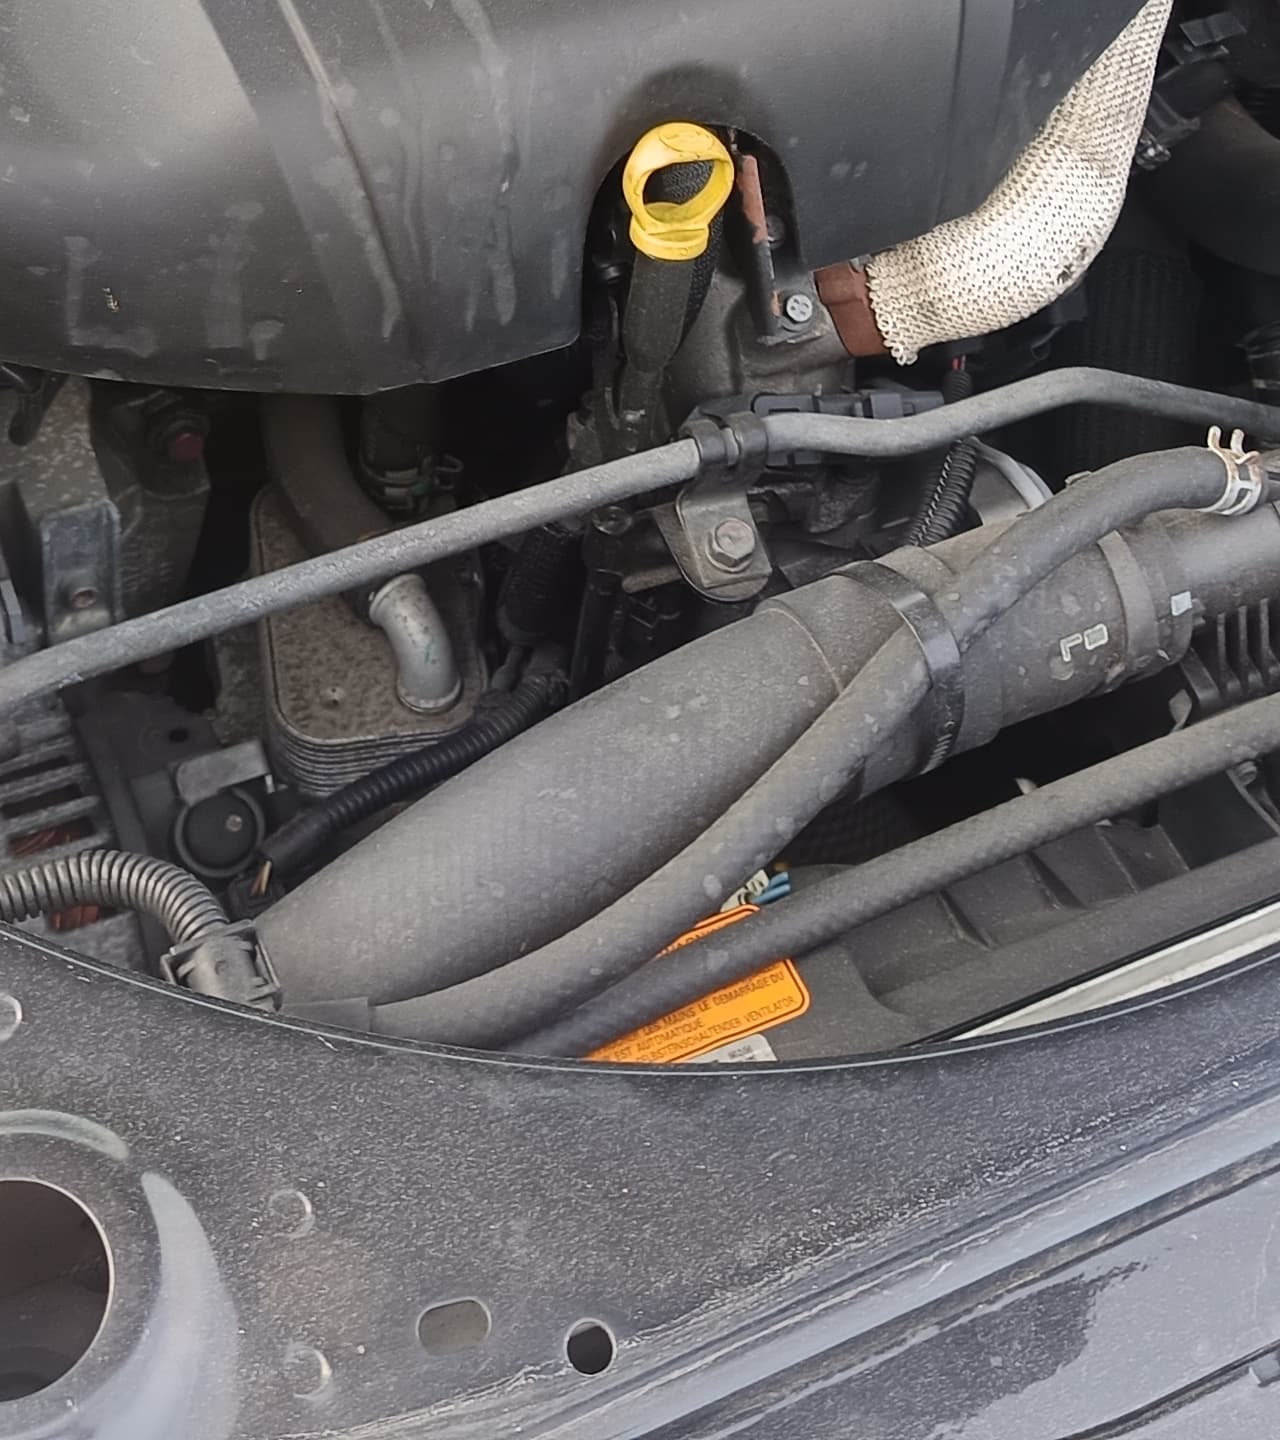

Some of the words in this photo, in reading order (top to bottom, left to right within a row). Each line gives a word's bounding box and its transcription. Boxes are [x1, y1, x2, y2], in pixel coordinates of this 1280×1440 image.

[663, 1007, 697, 1025] MAINS
[698, 999, 713, 1013] LE
[770, 970, 785, 984] DU
[743, 995, 798, 1023] VENTILATOR
[637, 1017, 705, 1051] AUTOMATIQUE
